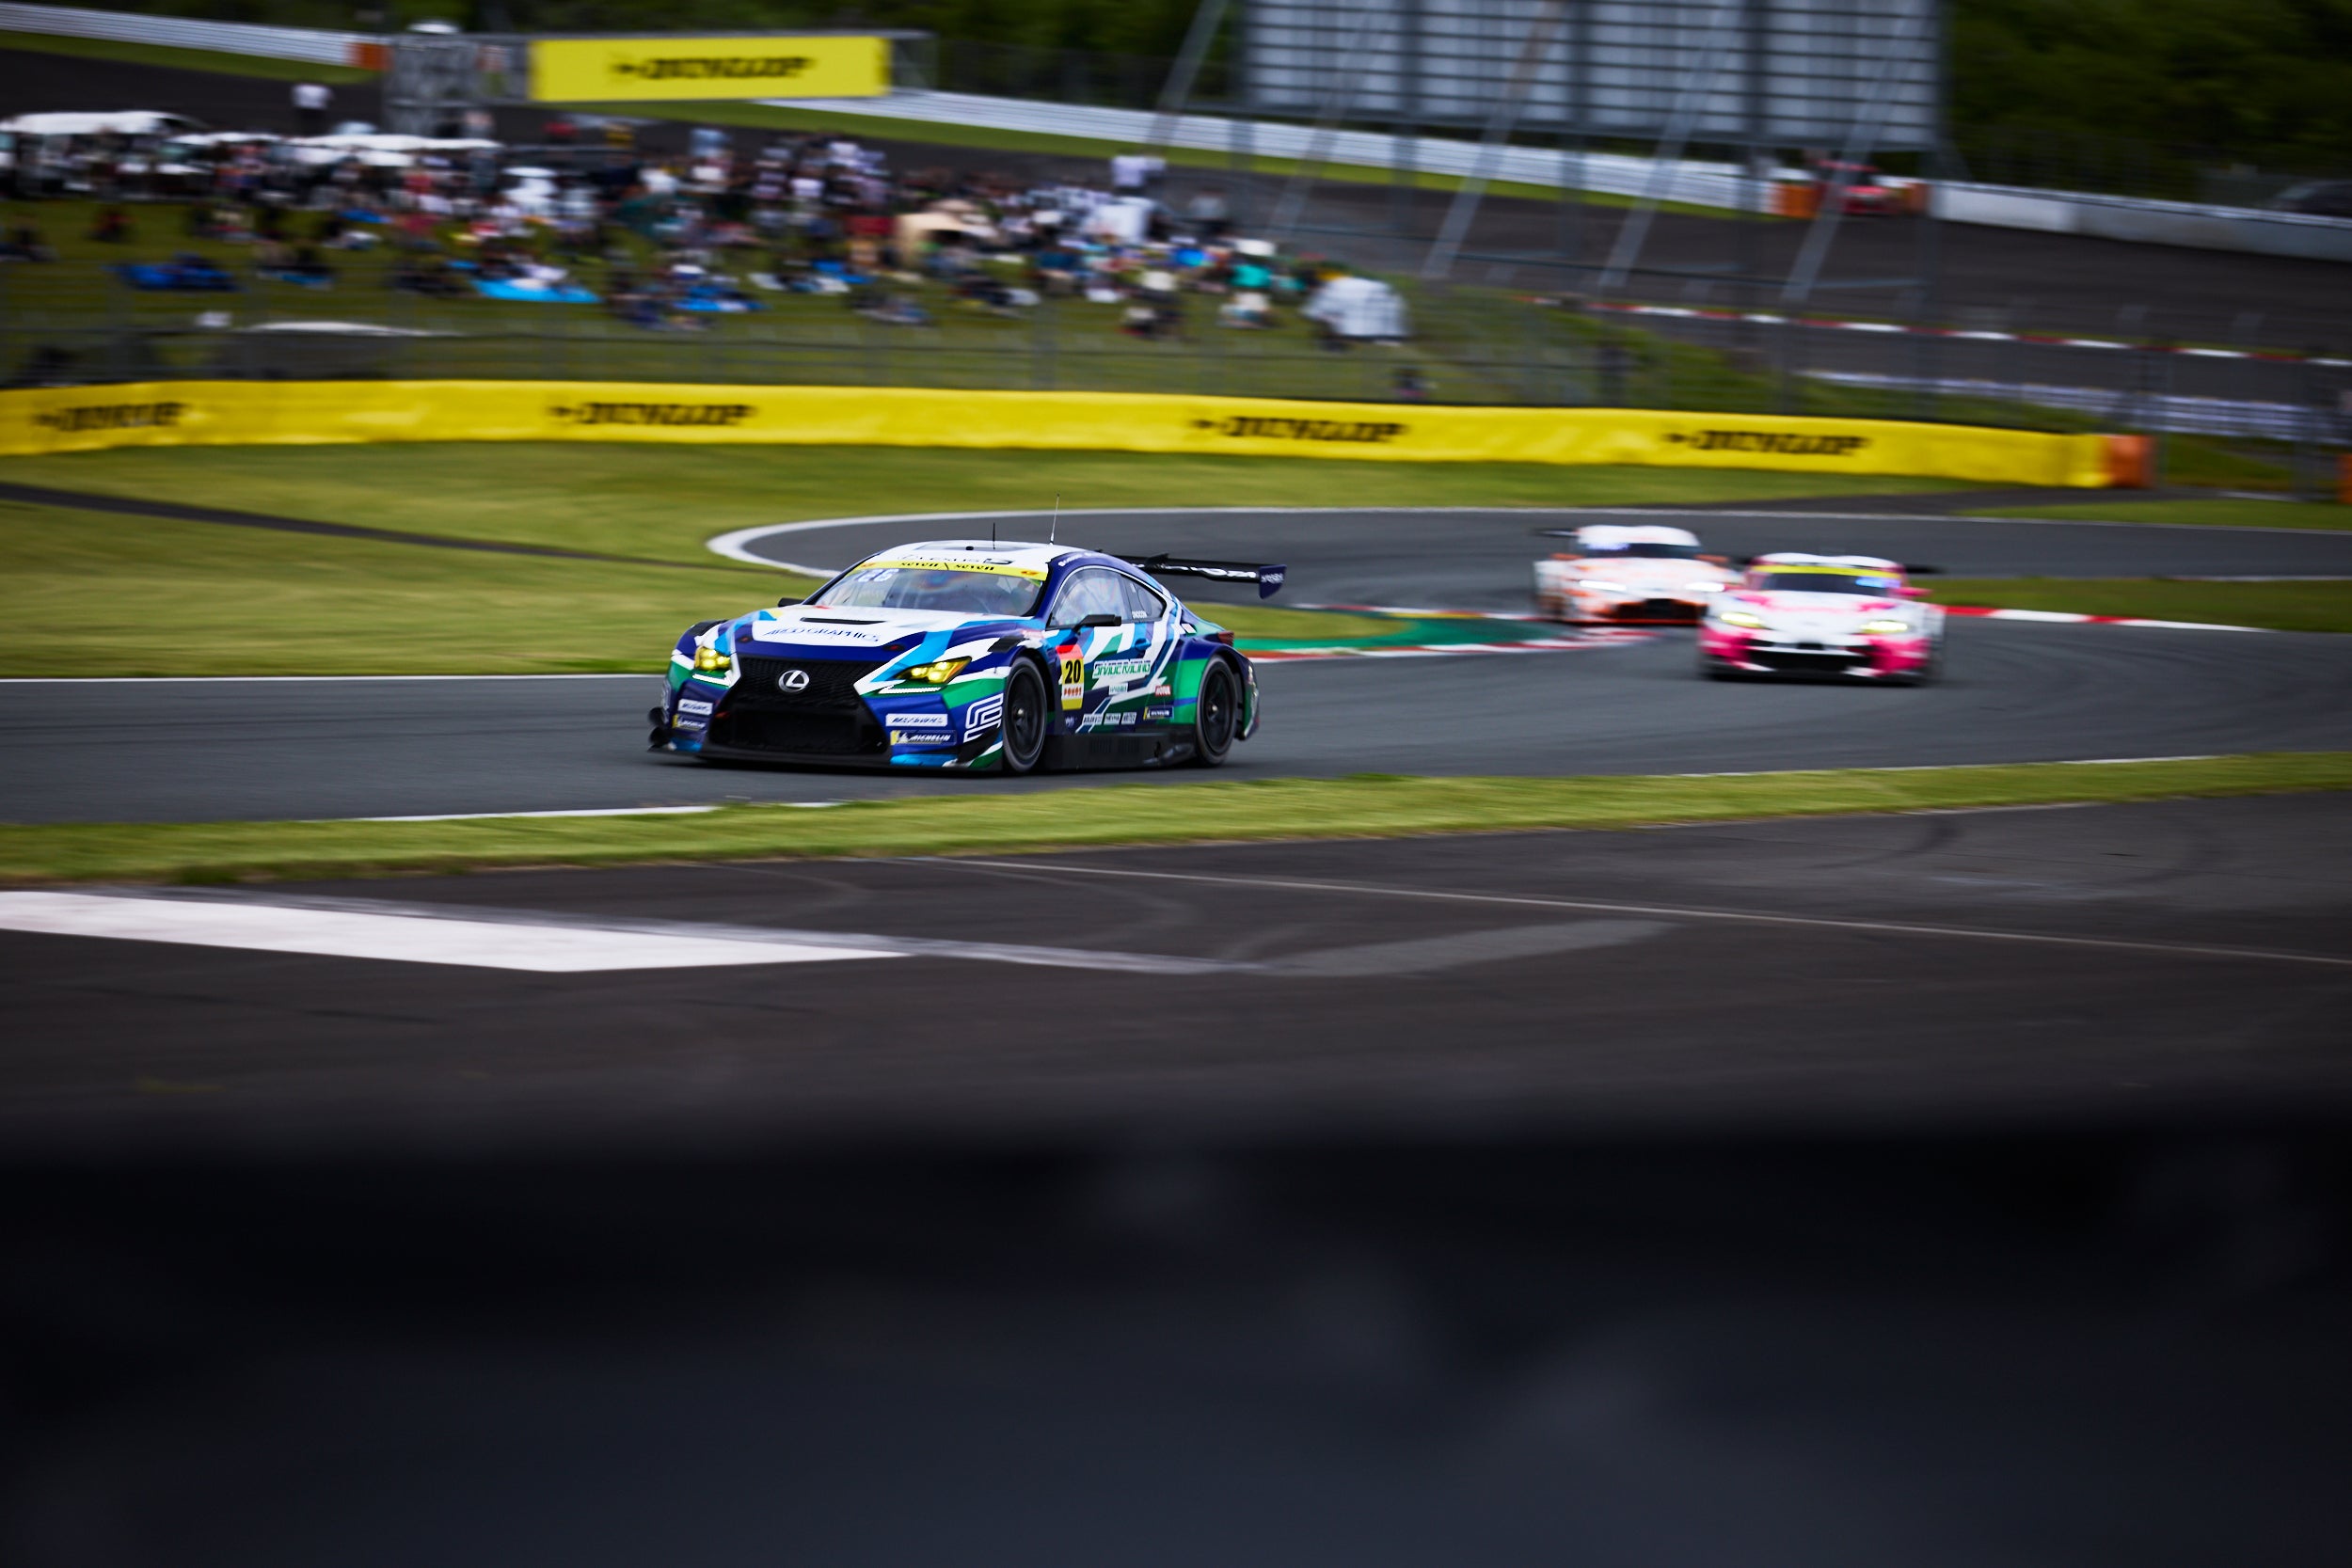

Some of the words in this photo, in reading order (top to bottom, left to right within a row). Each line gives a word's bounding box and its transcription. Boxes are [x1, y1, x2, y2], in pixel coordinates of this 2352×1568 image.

[643, 57, 815, 79] DUNLOP
[579, 403, 758, 425] DUNLOP
[1223, 417, 1407, 443] DUNLOP
[1691, 430, 1871, 456] DUNLOP
[1064, 659, 1081, 684] 20
[911, 734, 952, 742] MICHELIN
